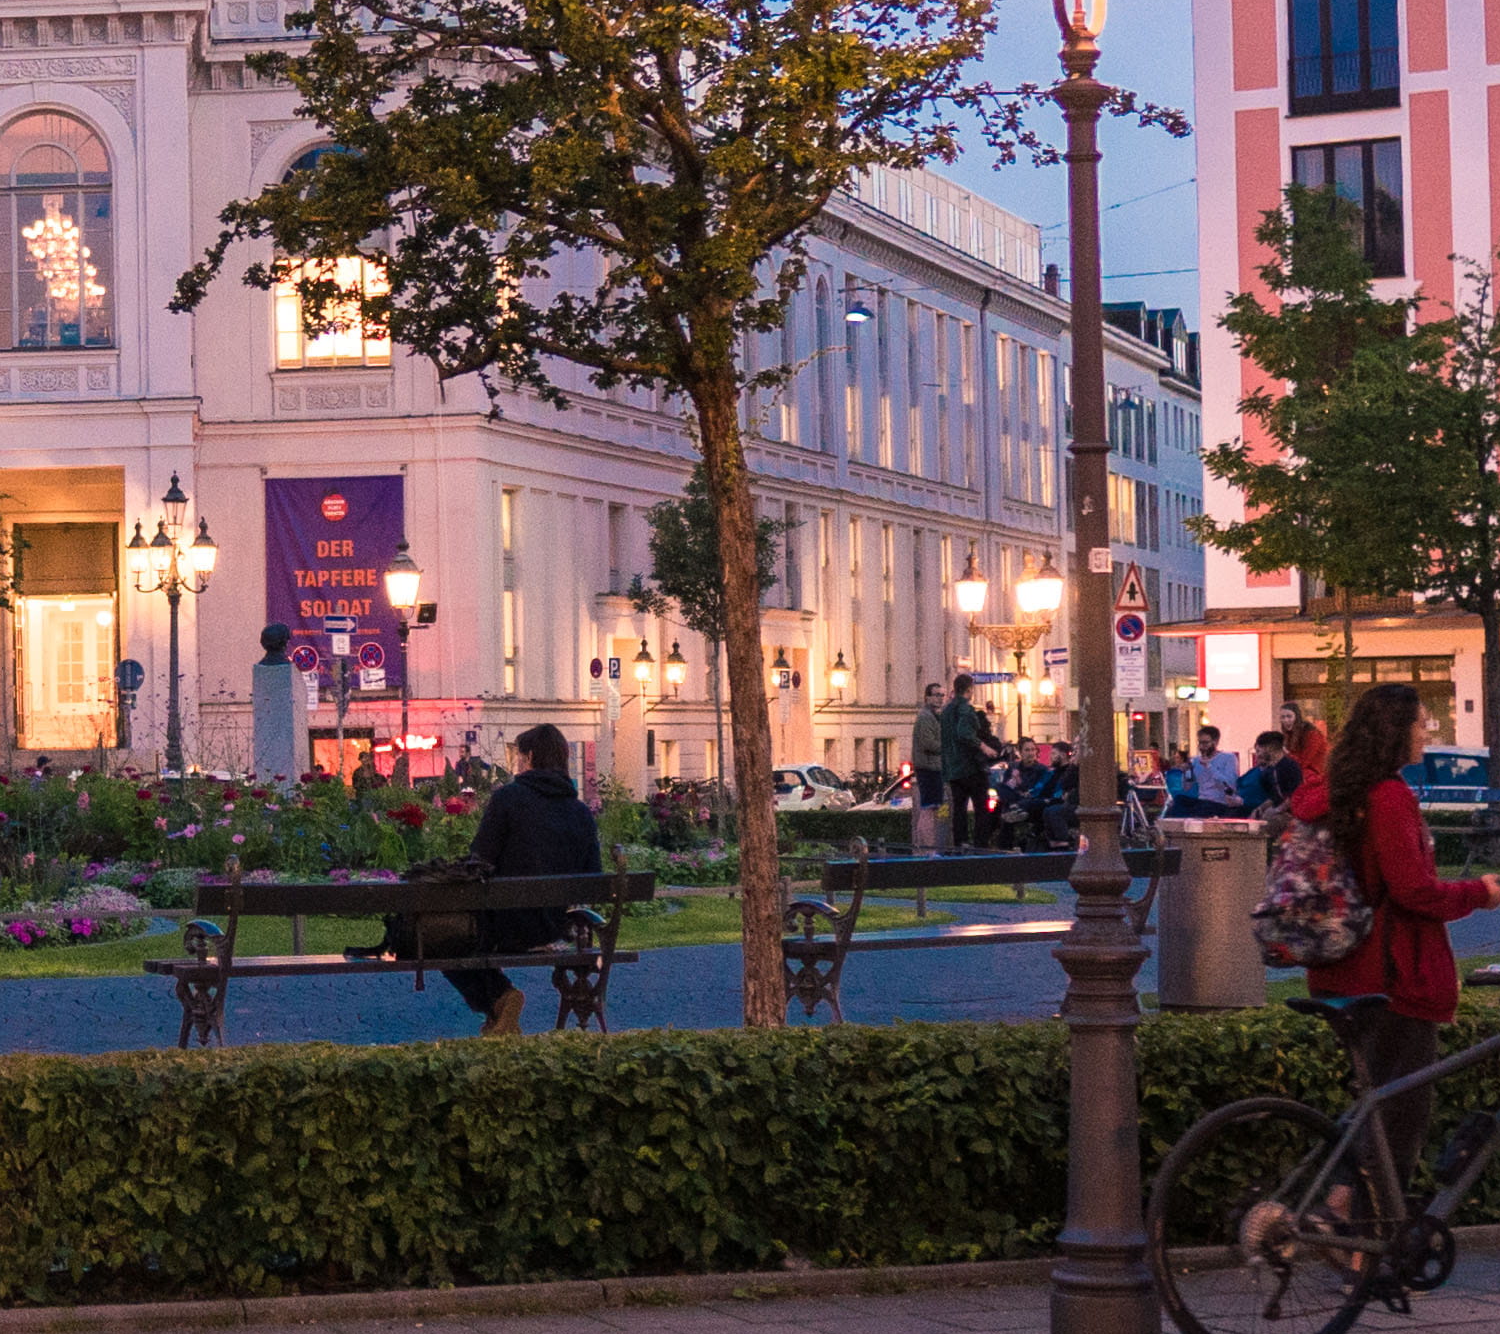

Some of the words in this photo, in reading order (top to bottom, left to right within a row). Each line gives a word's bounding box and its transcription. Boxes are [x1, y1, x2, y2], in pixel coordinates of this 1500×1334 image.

[316, 540, 354, 558] DER
[294, 569, 378, 587] TAPFERE
[300, 599, 373, 618] SOLDAT
